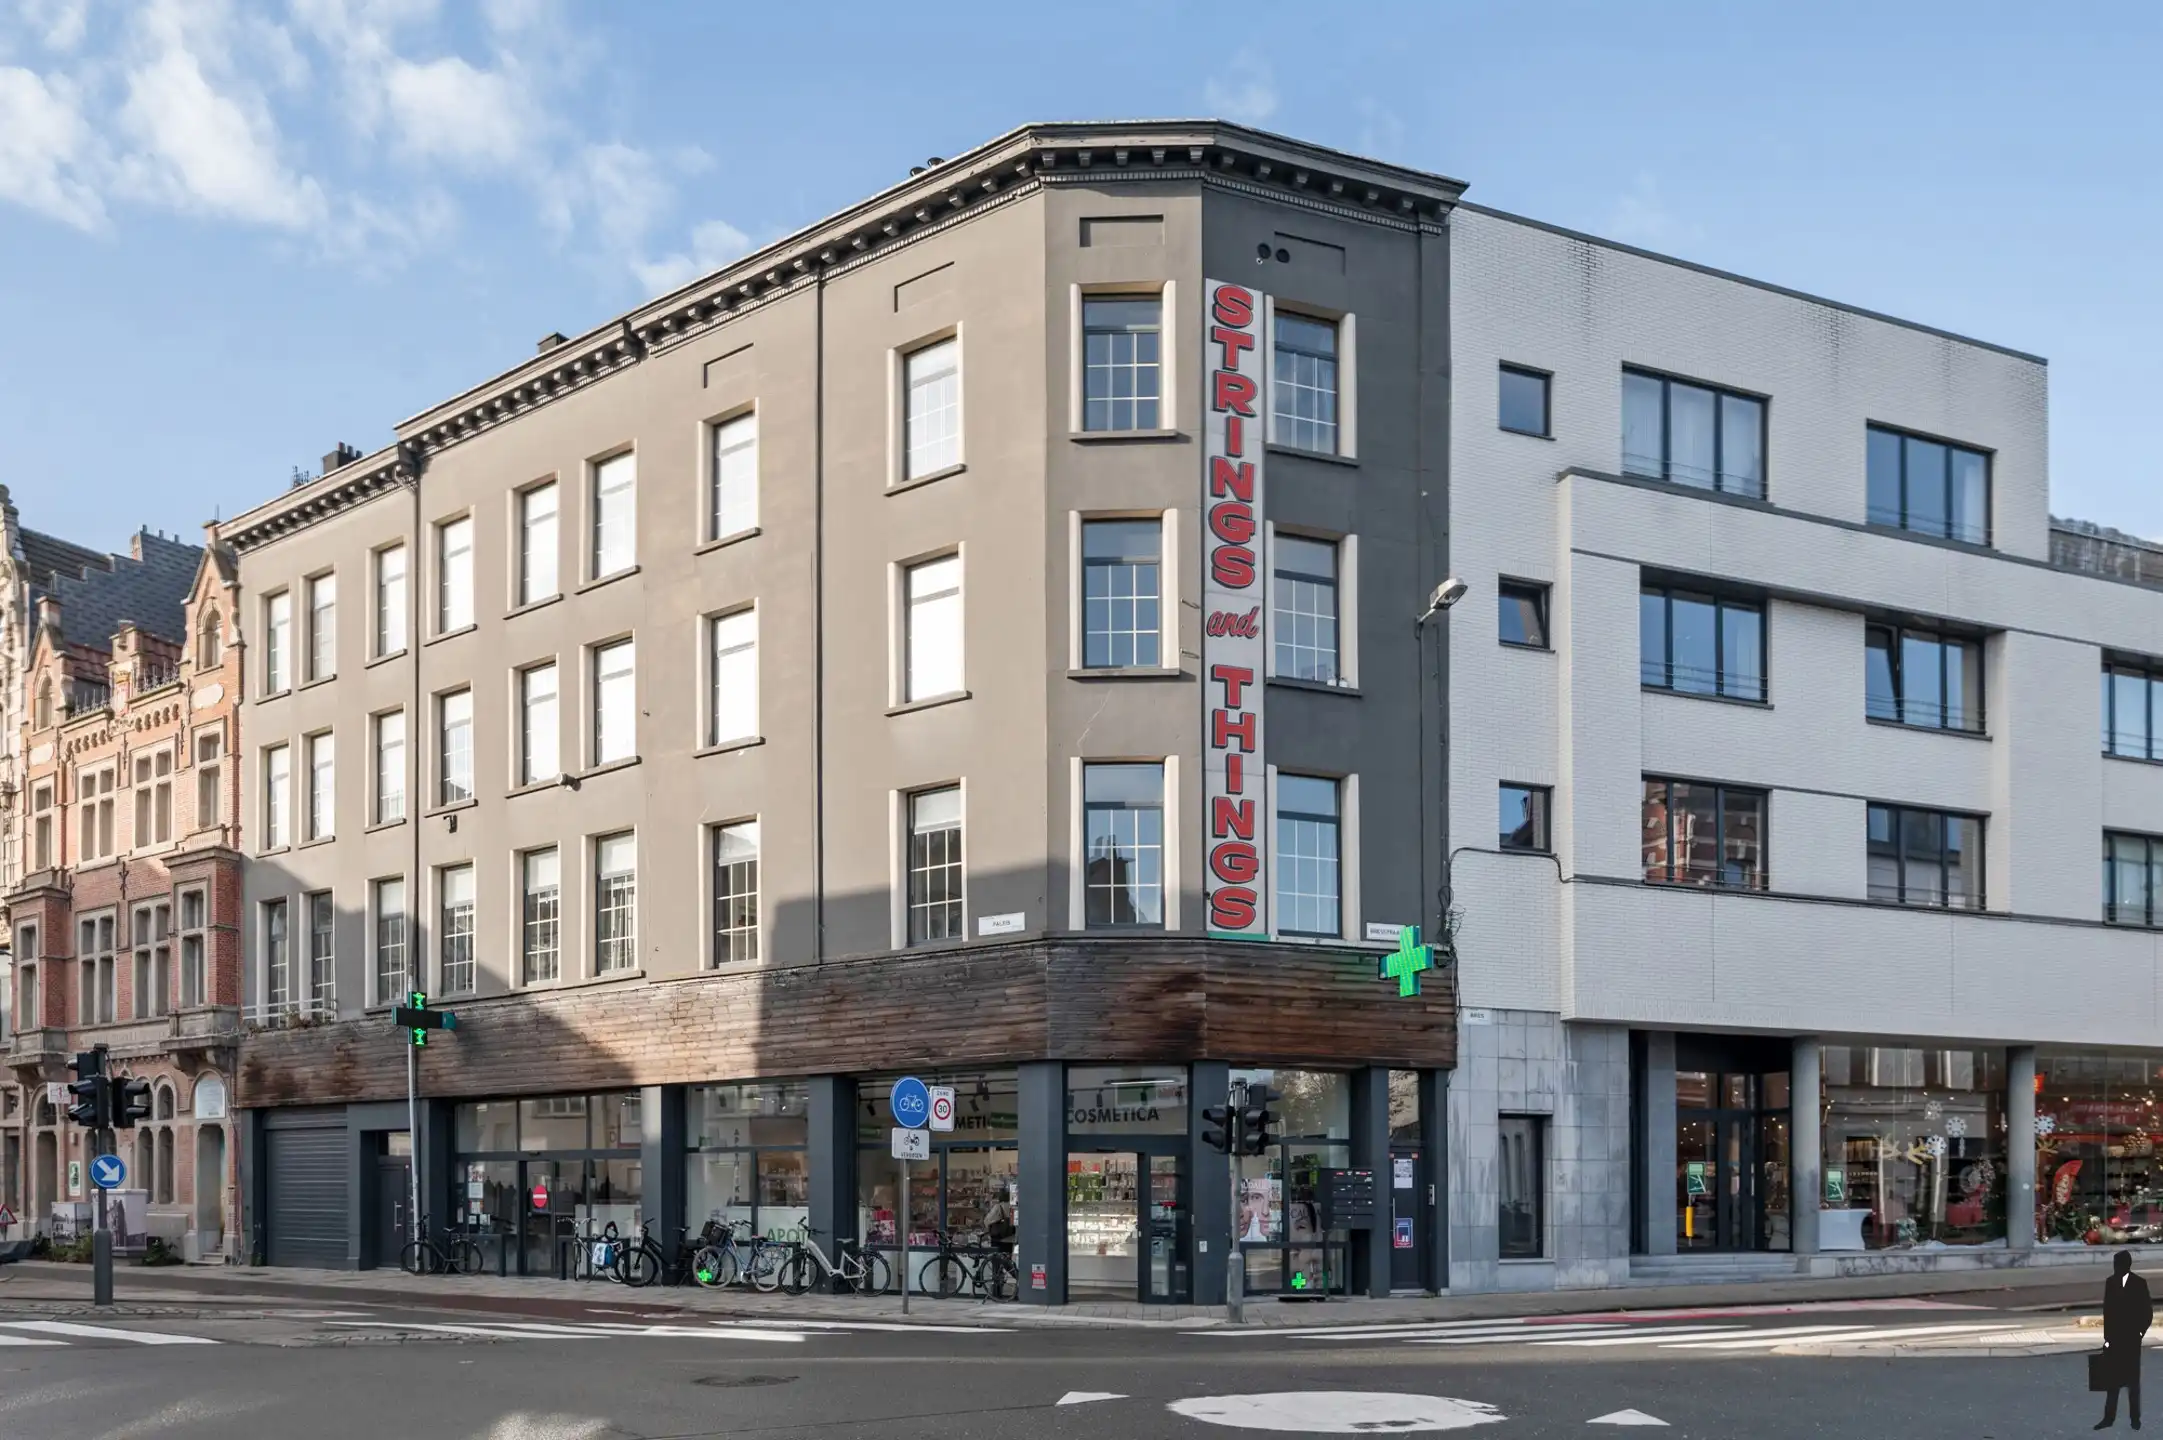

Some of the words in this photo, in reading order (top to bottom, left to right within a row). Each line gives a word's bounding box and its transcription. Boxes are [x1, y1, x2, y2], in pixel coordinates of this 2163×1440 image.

[1208, 284, 1258, 589] STRINGS
[1206, 606, 1259, 637] and
[1209, 664, 1259, 929] THINGS
[938, 1104, 947, 1113] 30
